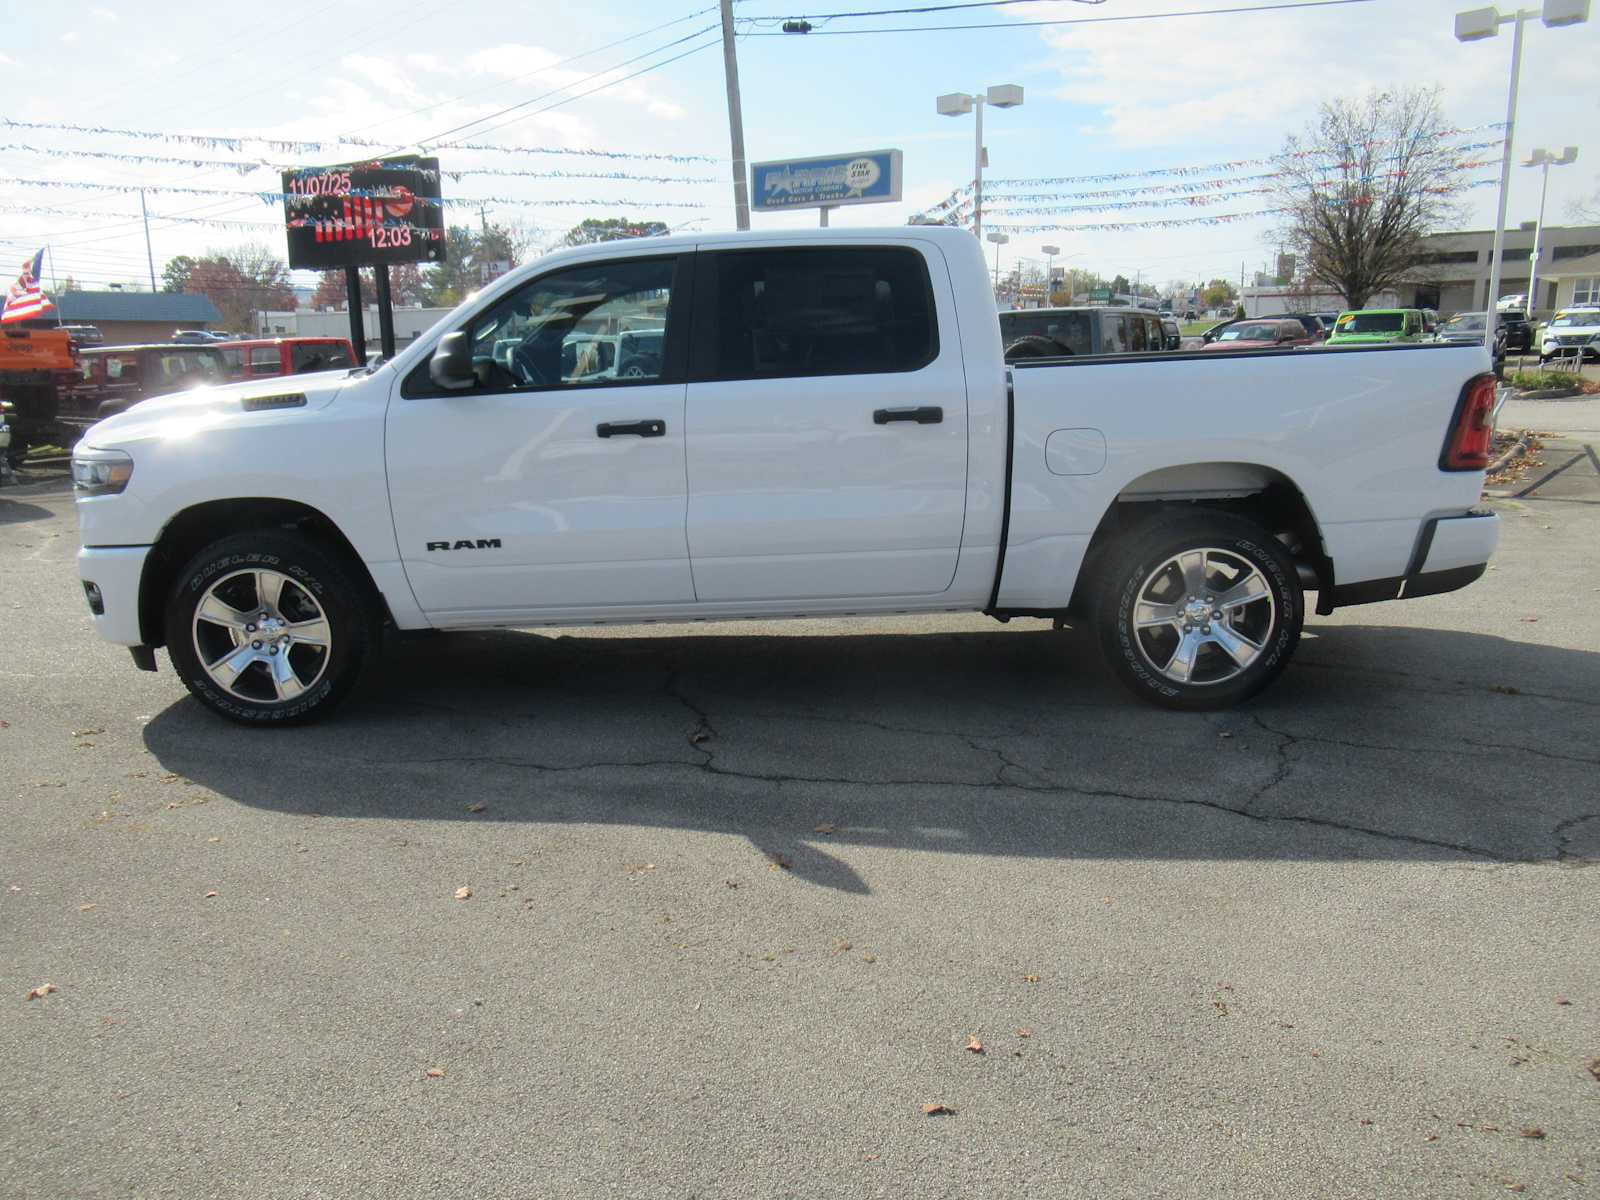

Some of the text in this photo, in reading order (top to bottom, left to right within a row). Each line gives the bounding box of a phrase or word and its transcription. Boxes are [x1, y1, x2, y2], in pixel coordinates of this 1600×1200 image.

[289, 173, 352, 195] 11/07/25
[369, 226, 411, 248] 12:03
[426, 538, 502, 551] RAM
